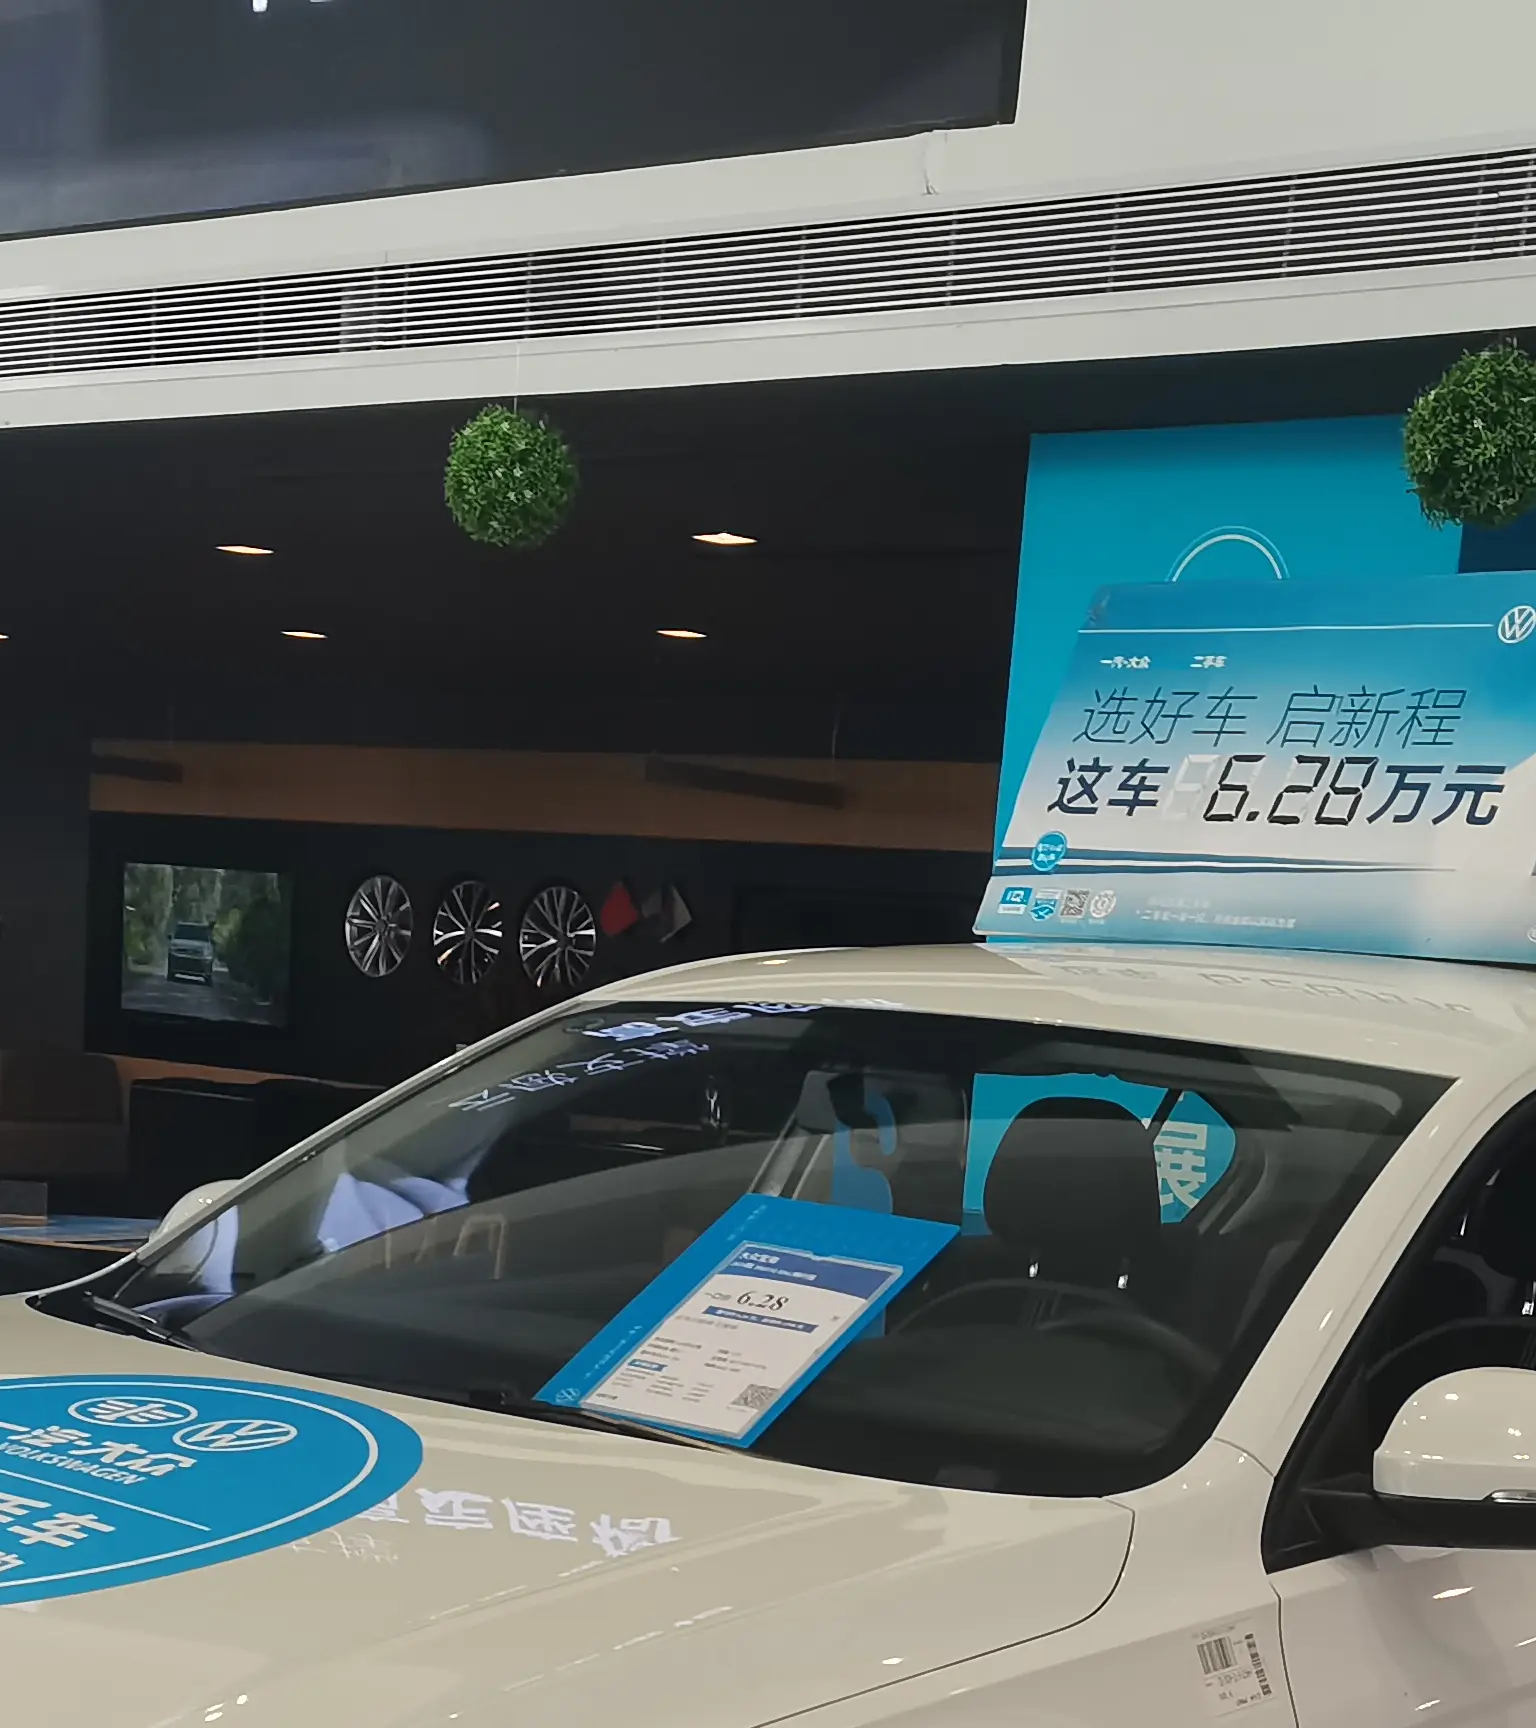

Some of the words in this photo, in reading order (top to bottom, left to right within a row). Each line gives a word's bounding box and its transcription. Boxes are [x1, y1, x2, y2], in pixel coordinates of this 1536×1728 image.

[1072, 686, 1258, 748] 选好车
[1265, 684, 1468, 750] 启新程
[1047, 756, 1170, 816] 这车
[736, 1289, 789, 1312] 6.28
